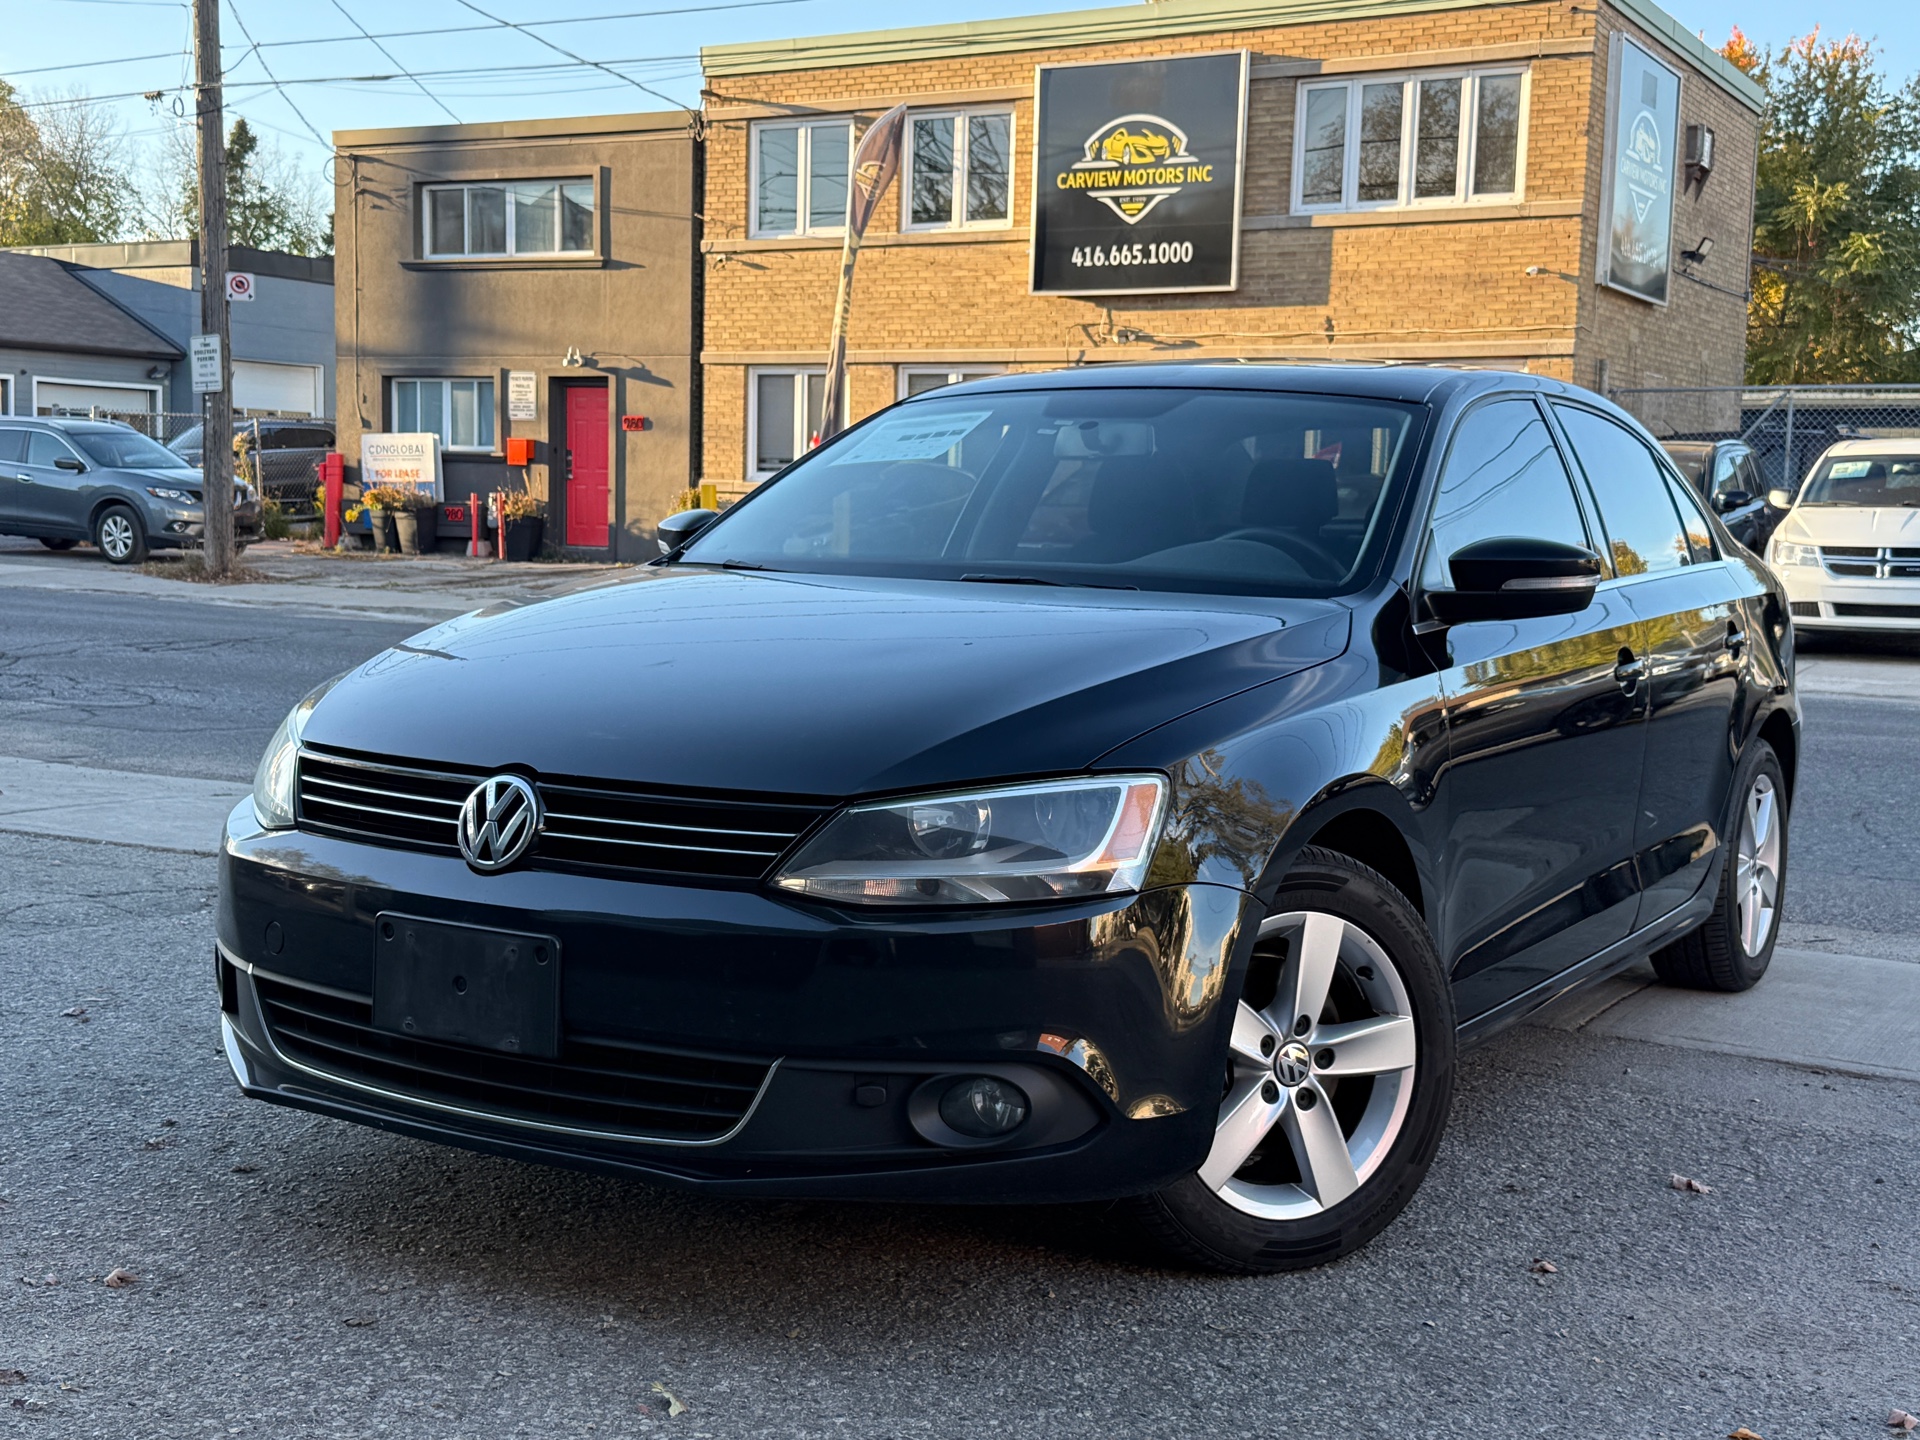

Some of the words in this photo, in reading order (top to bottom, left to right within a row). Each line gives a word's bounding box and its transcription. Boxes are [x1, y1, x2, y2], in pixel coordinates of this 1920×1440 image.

[1056, 171, 1122, 189] CARVIEW
[1123, 166, 1184, 186] MOTORS
[1187, 164, 1214, 183] INC
[1620, 157, 1639, 181] CARVIEW
[1640, 166, 1659, 188] MOTORS
[1071, 241, 1193, 267] 416.665.1000
[368, 444, 425, 455] CDNGLOBAL
[375, 468, 393, 479] FOR
[394, 468, 420, 479] LEASE
[444, 508, 463, 520] 980
[460, 775, 535, 869] VW
